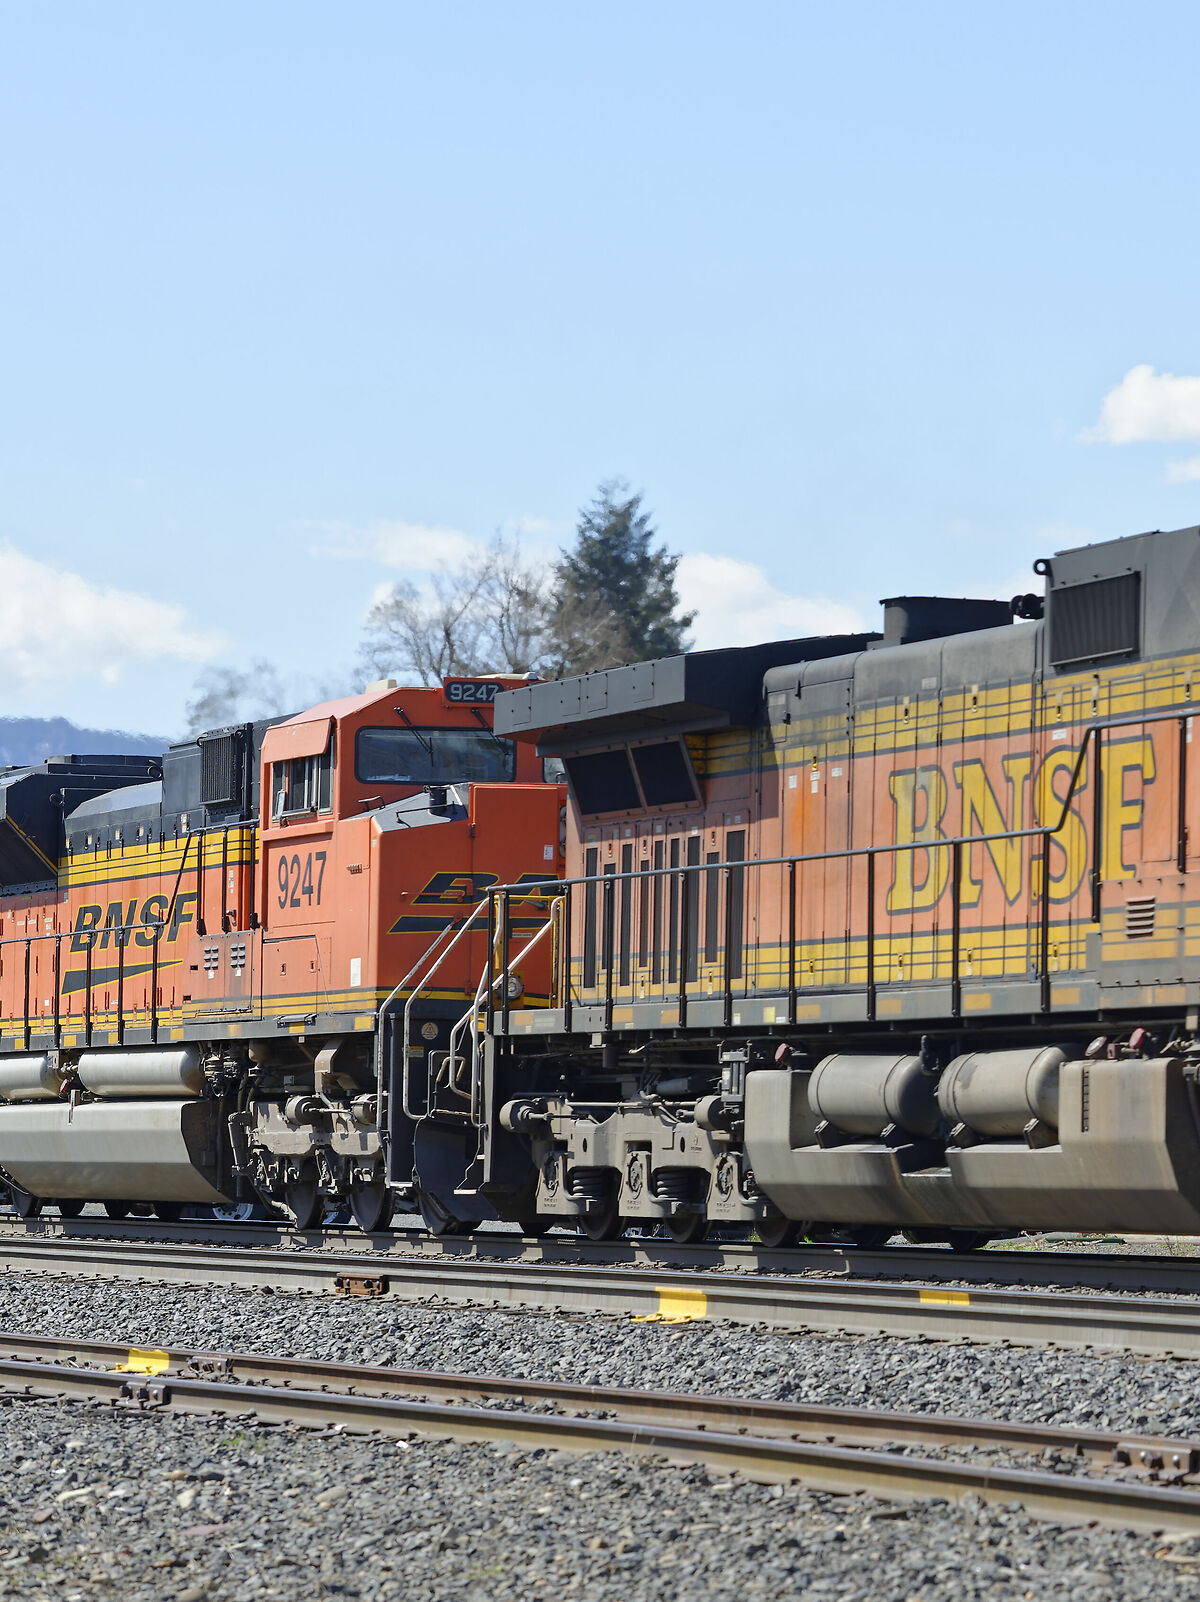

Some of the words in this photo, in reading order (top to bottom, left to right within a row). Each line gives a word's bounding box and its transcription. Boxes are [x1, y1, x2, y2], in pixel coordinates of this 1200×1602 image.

[450, 683, 499, 701] 9247
[886, 733, 1157, 916] BNSF
[278, 850, 327, 910] 9247
[69, 889, 199, 955] BNSF
